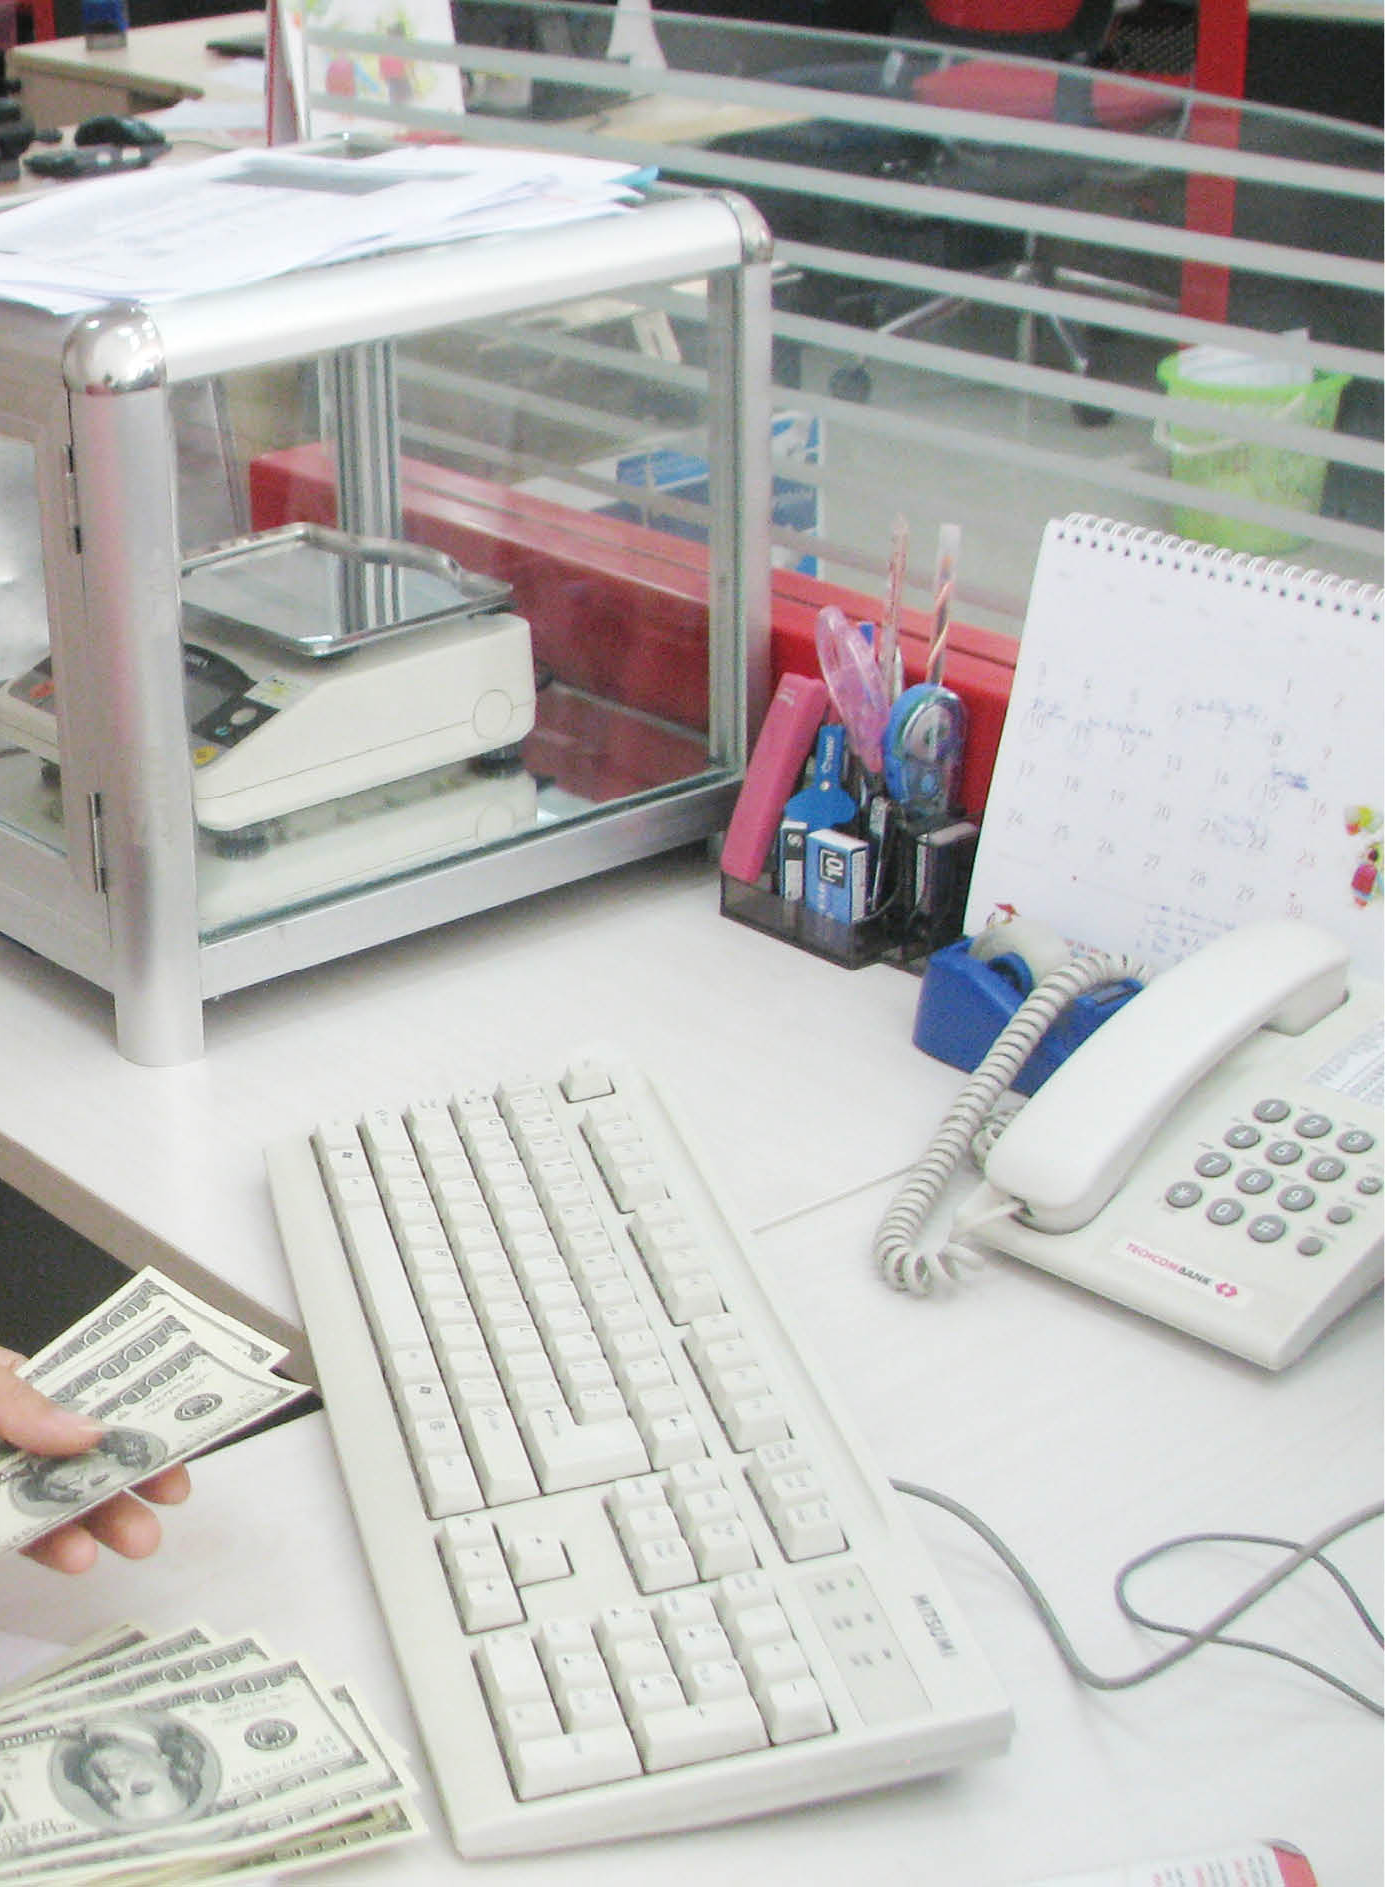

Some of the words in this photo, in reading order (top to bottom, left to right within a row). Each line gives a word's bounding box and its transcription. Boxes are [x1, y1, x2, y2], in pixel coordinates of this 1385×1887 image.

[825, 858, 845, 878] 10
[1127, 1242, 1212, 1286] TECHCOMBANK
[910, 1593, 958, 1657] MITSUMI
